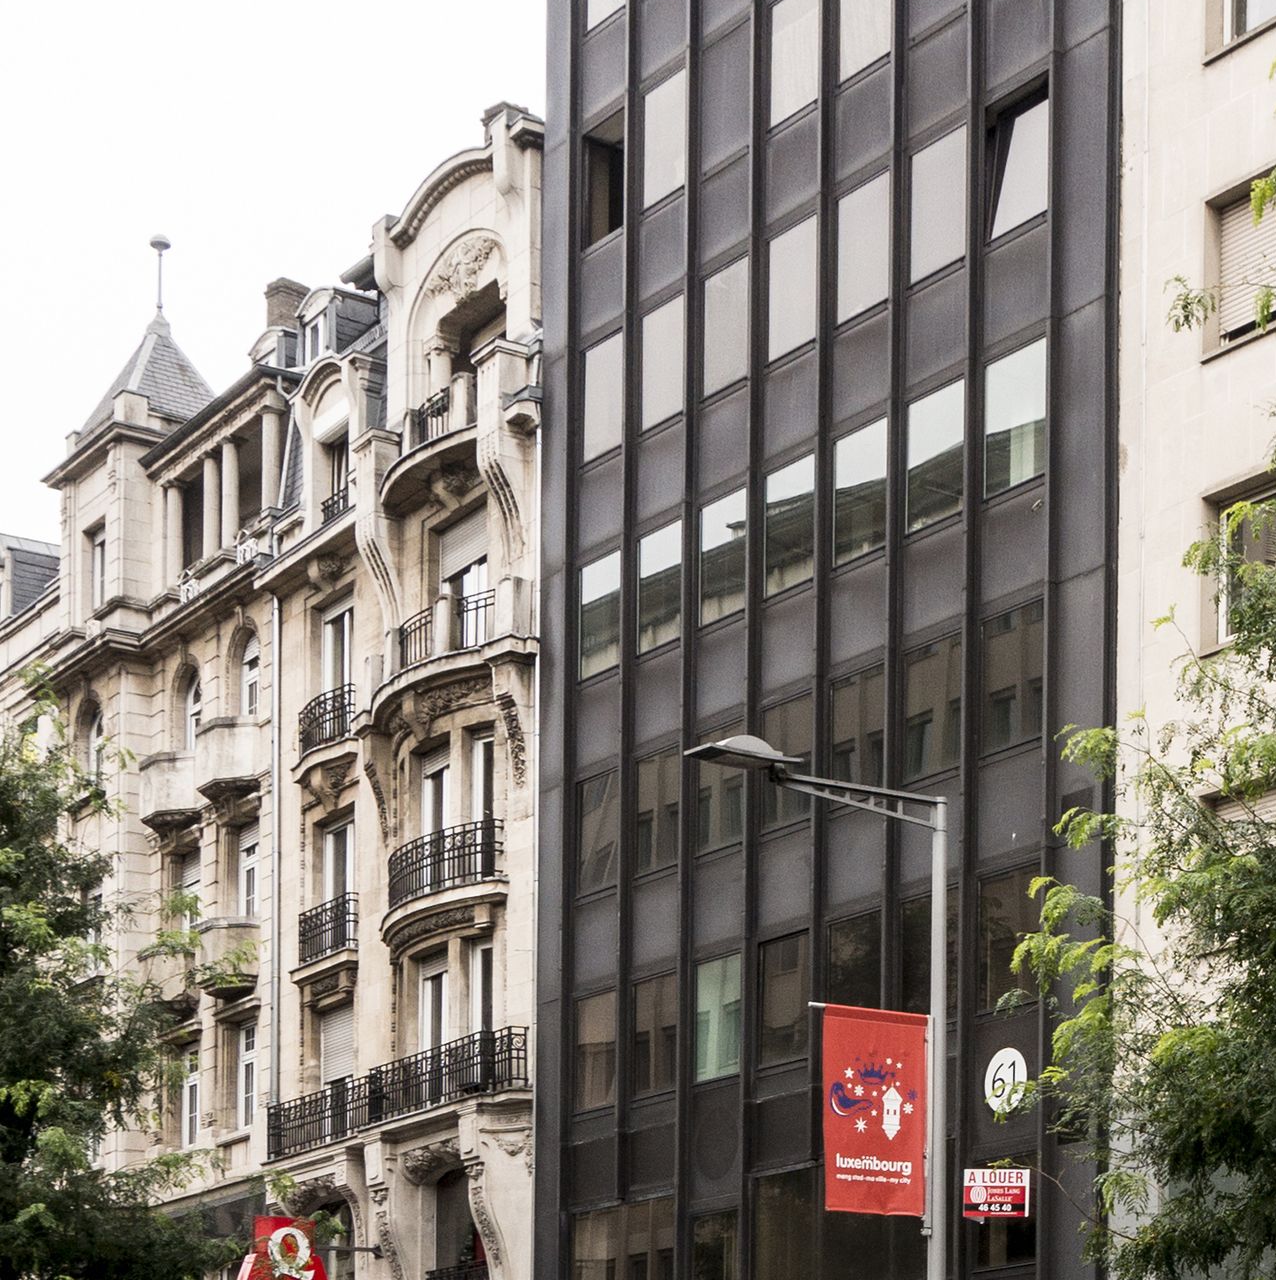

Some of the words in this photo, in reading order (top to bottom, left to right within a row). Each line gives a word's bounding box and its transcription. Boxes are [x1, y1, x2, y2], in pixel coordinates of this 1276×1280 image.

[992, 1060, 1016, 1098] 61
[969, 1171, 976, 1183] A
[982, 1171, 1023, 1184] LOUER
